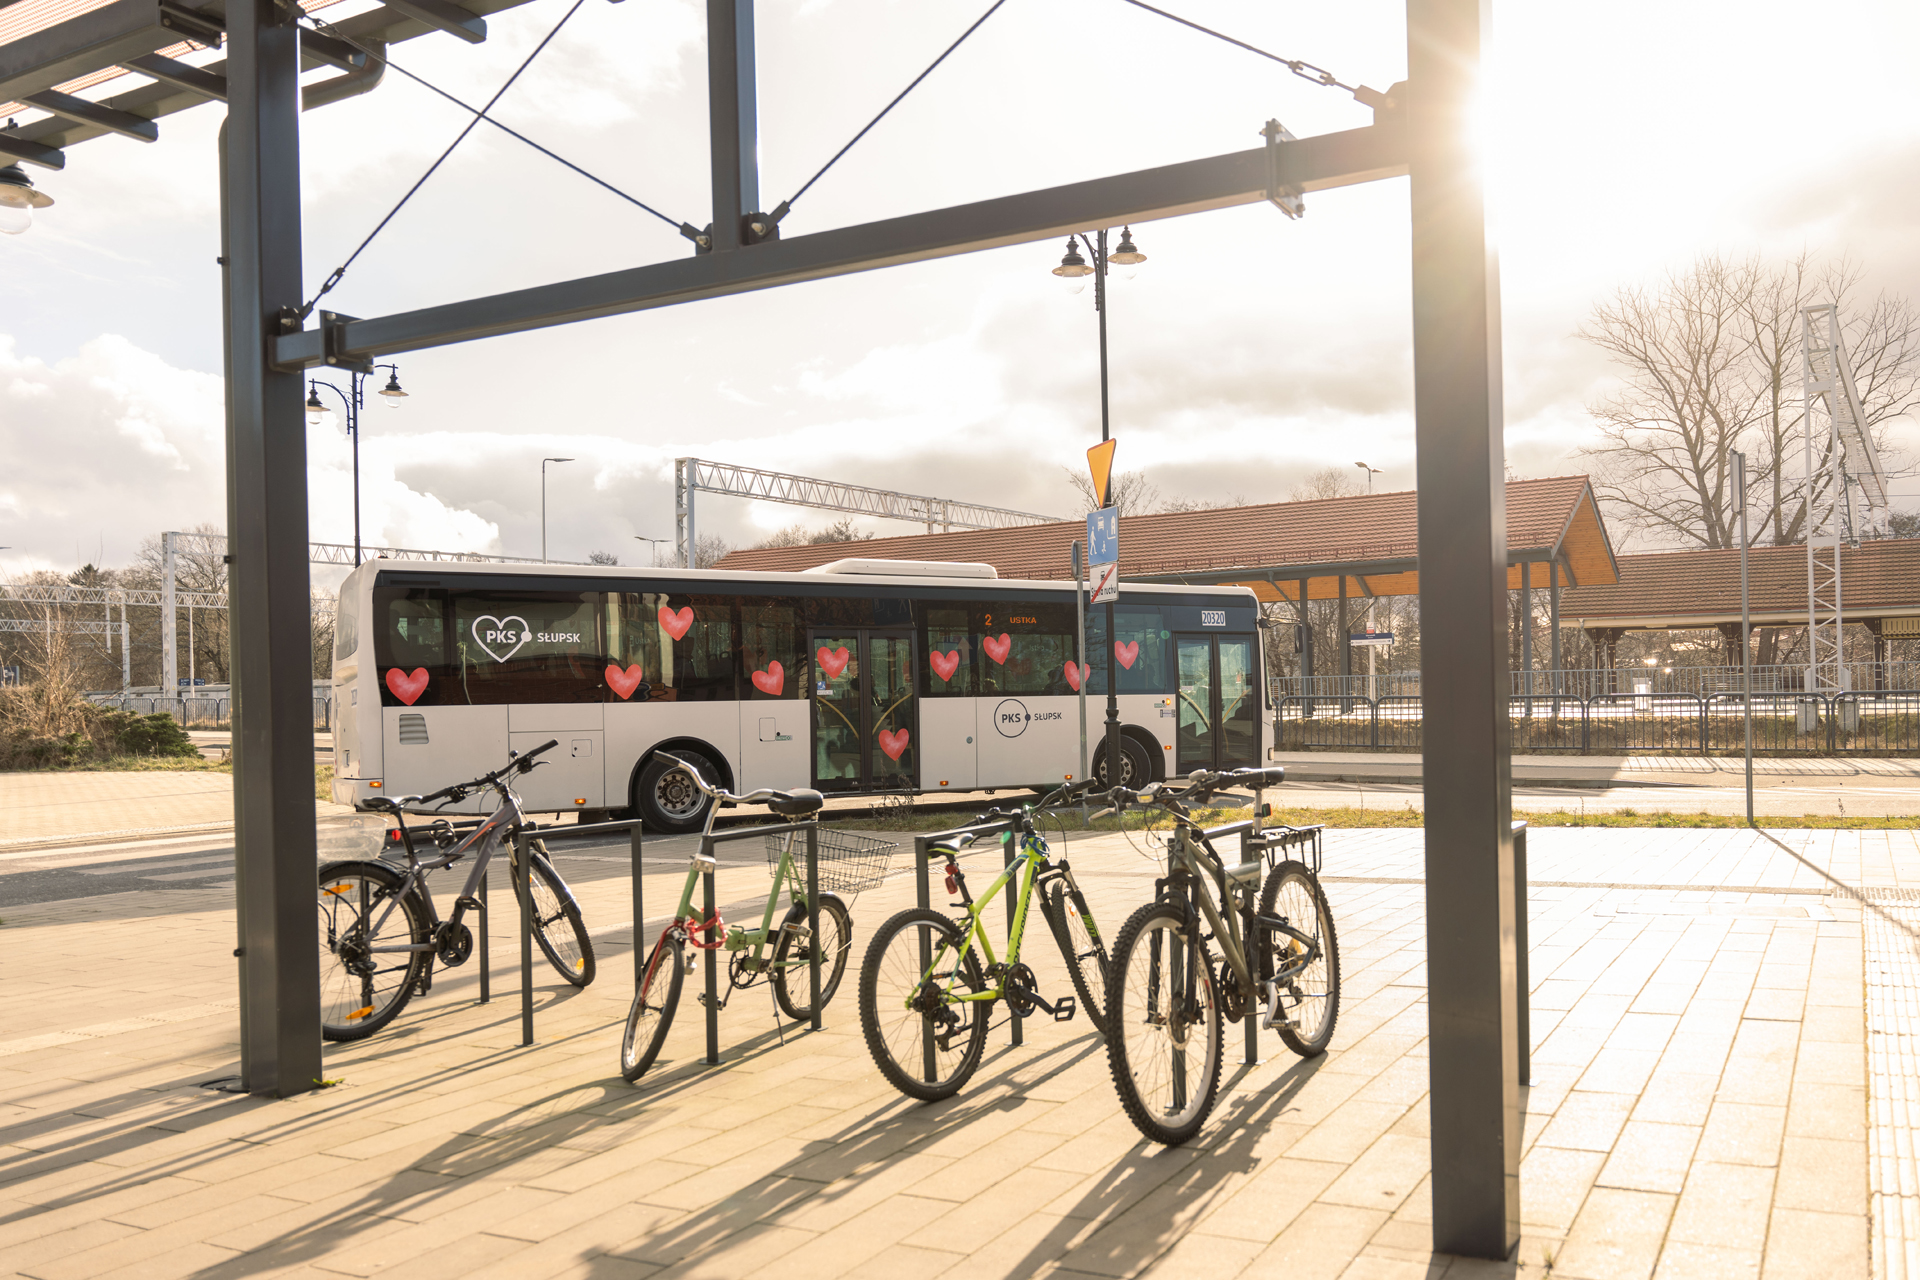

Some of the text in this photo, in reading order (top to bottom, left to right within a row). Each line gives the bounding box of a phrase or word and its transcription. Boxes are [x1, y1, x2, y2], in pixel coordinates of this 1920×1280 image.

[985, 613, 1037, 626] 2 USTKA
[1202, 612, 1225, 625] 20320
[486, 630, 581, 643] PKS SŁUPSK
[1001, 712, 1062, 723] PKS SŁUPSK
